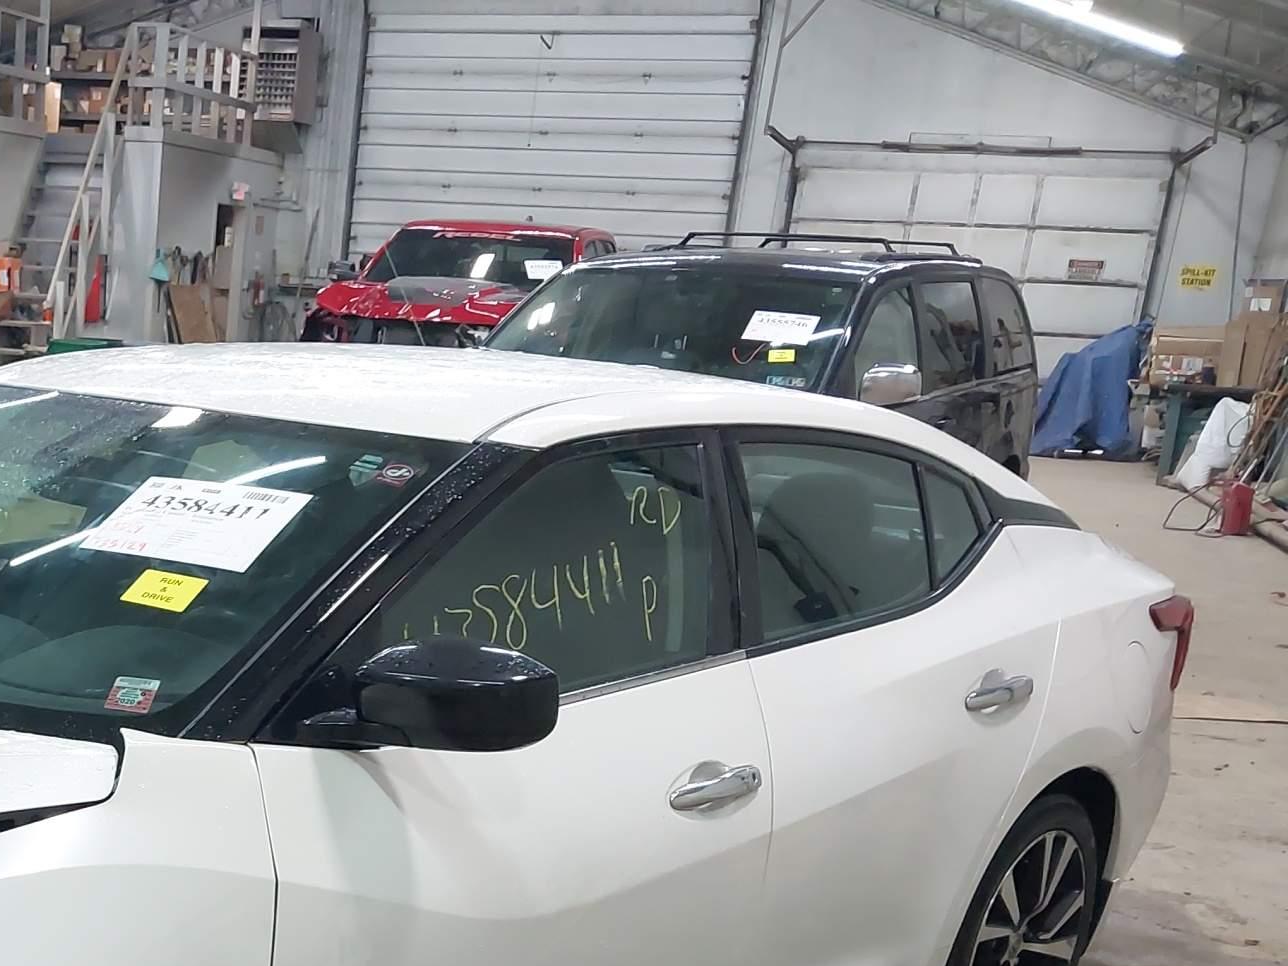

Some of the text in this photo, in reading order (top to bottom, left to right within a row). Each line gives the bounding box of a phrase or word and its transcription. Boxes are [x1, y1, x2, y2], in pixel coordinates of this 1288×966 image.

[1181, 267, 1216, 277] SPILL-KIT
[1181, 277, 1212, 286] STATION
[141, 494, 271, 520] 43584411
[159, 577, 184, 587] RUN
[140, 591, 174, 603] DRIVE
